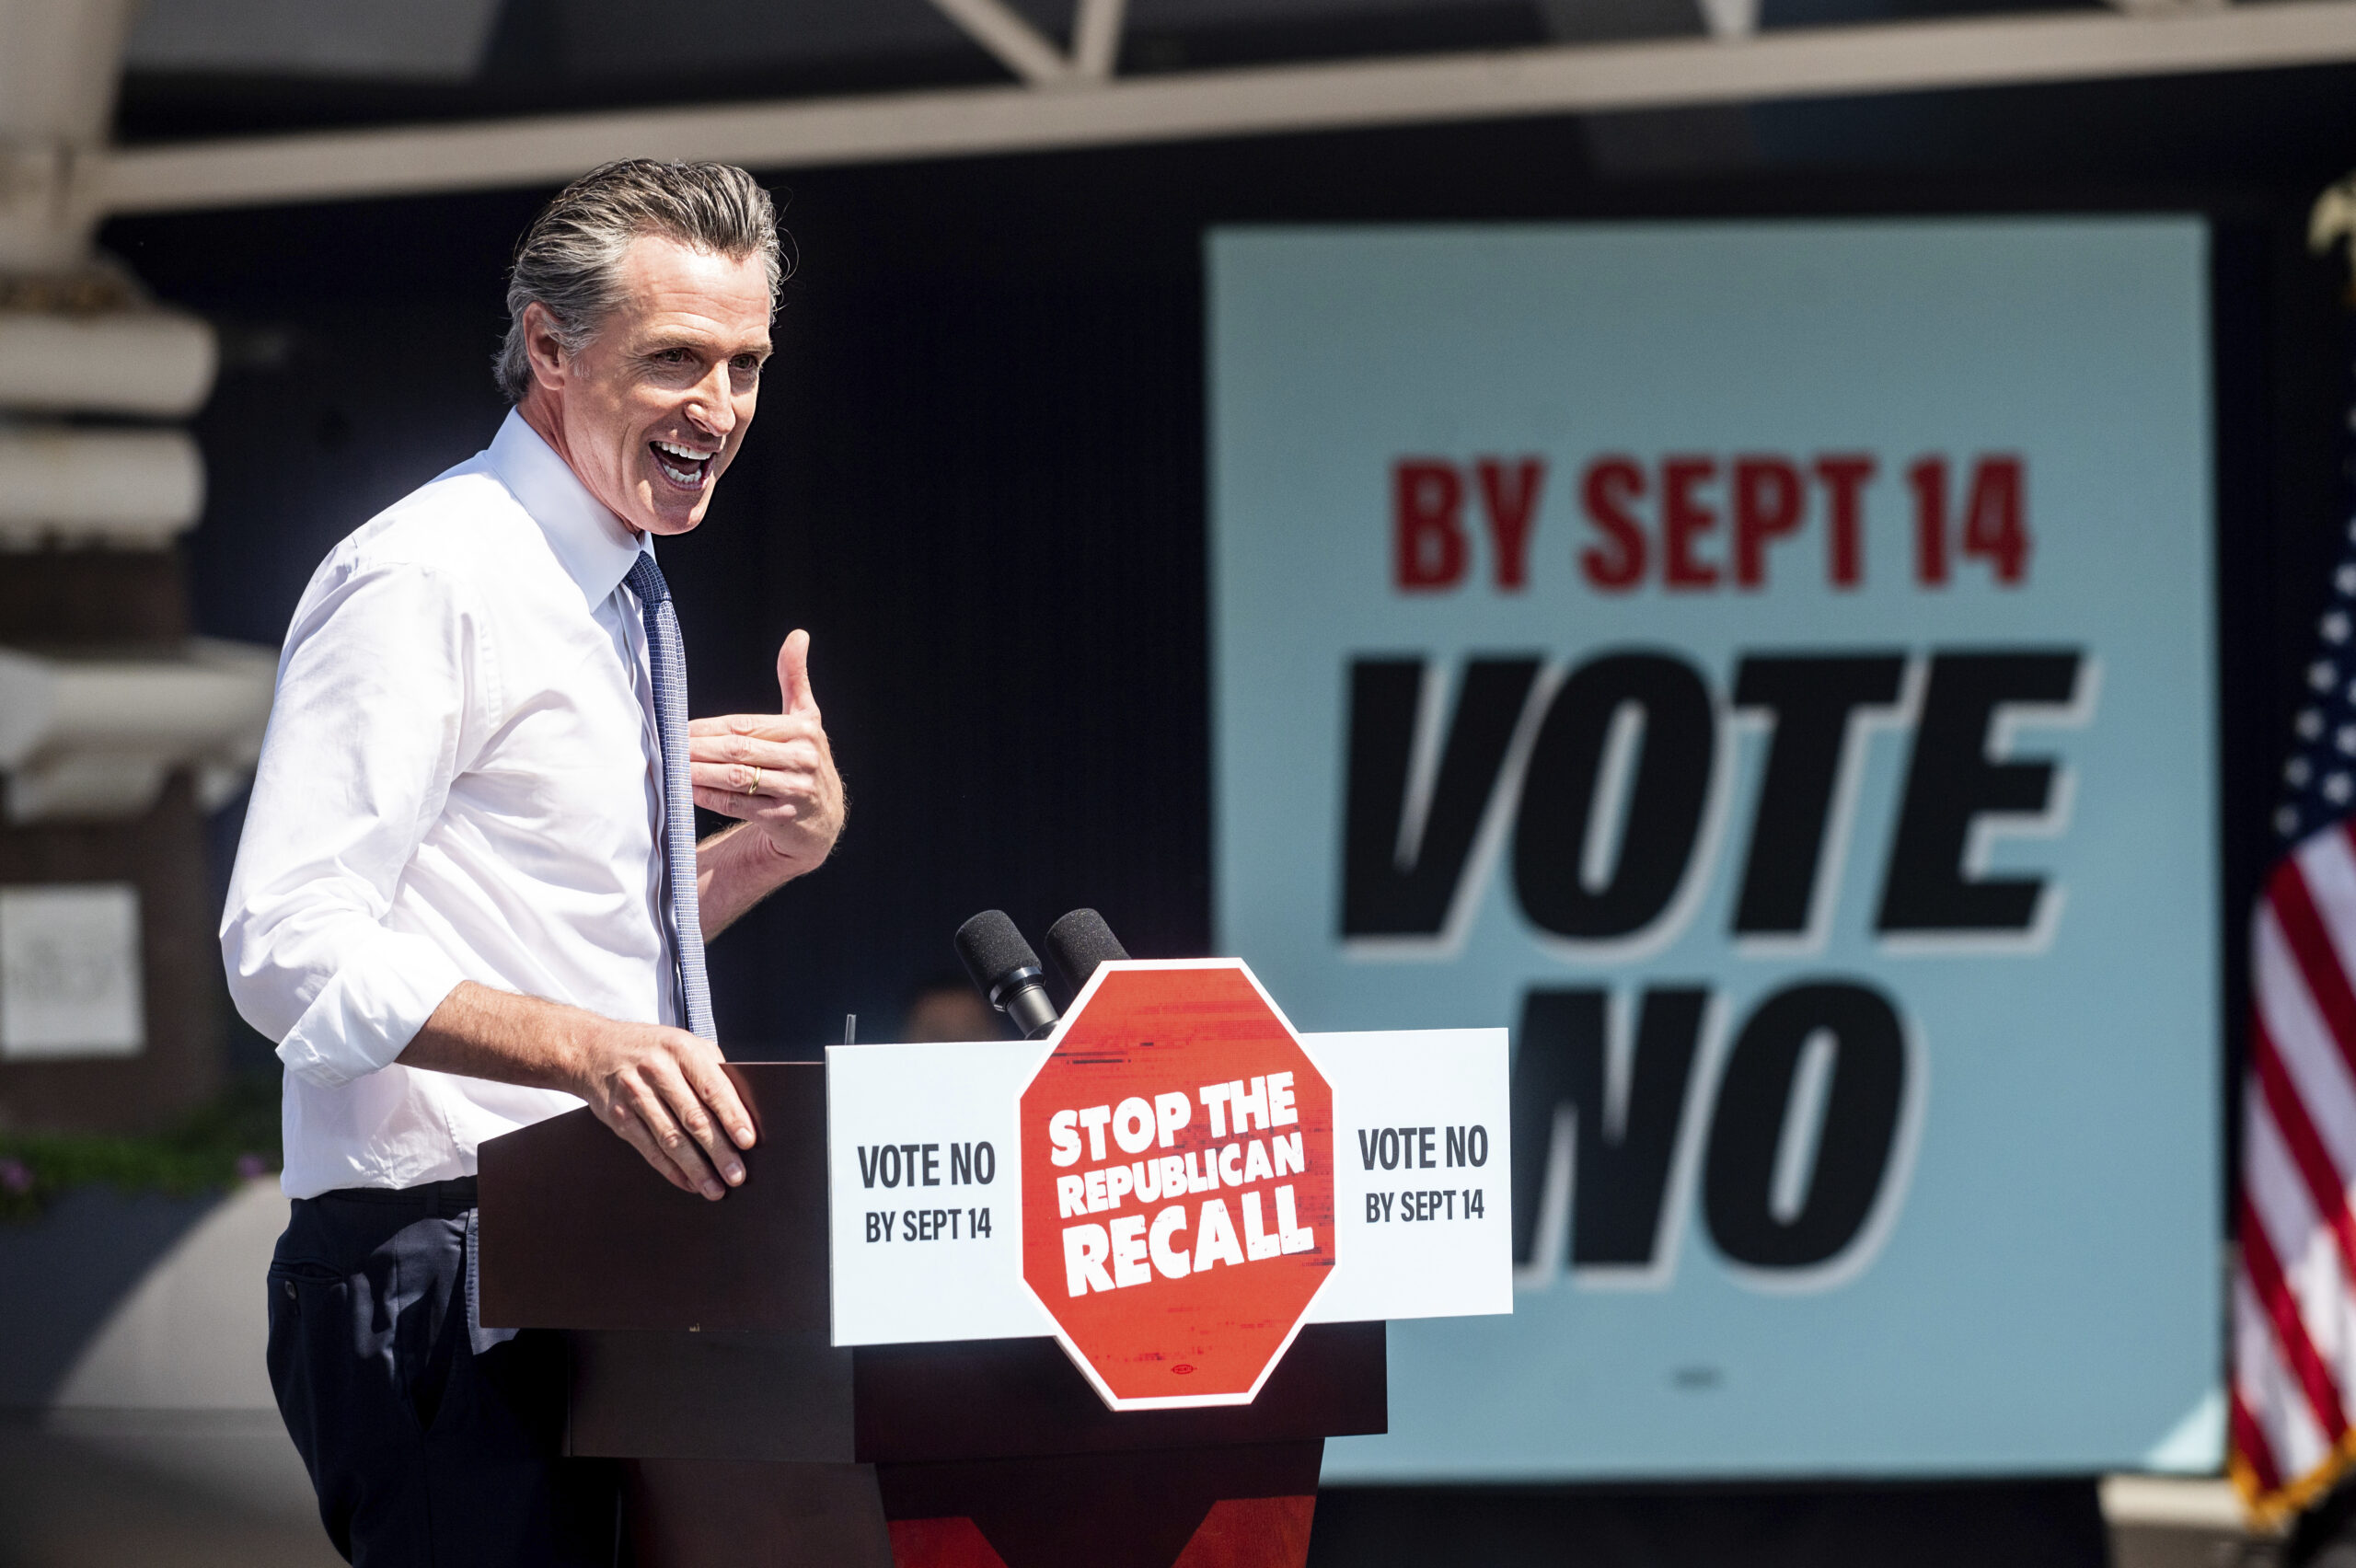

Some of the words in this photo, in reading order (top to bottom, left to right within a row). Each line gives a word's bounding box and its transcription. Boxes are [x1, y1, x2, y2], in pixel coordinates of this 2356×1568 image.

[1392, 456, 1545, 594] BY
[1578, 454, 1877, 594] SEPT
[1907, 452, 2031, 590] 14
[1336, 642, 2093, 953] VOTE
[857, 1143, 941, 1188] VOTE
[951, 1141, 996, 1185] NO
[1049, 1091, 1192, 1167] STOP
[1199, 1071, 1299, 1138] THE
[1357, 1126, 1437, 1170] VOTE
[1446, 1124, 1488, 1168] NO
[1510, 972, 1916, 1277] NO
[1057, 1131, 1305, 1219] REPUBLICAN
[1366, 1192, 1395, 1224] BY
[1401, 1190, 1457, 1222] SEPT
[1462, 1189, 1484, 1219] 14
[866, 1211, 896, 1243] BY
[903, 1208, 962, 1241] SEPT
[968, 1207, 991, 1239] 14
[1062, 1184, 1315, 1297] RECALL
